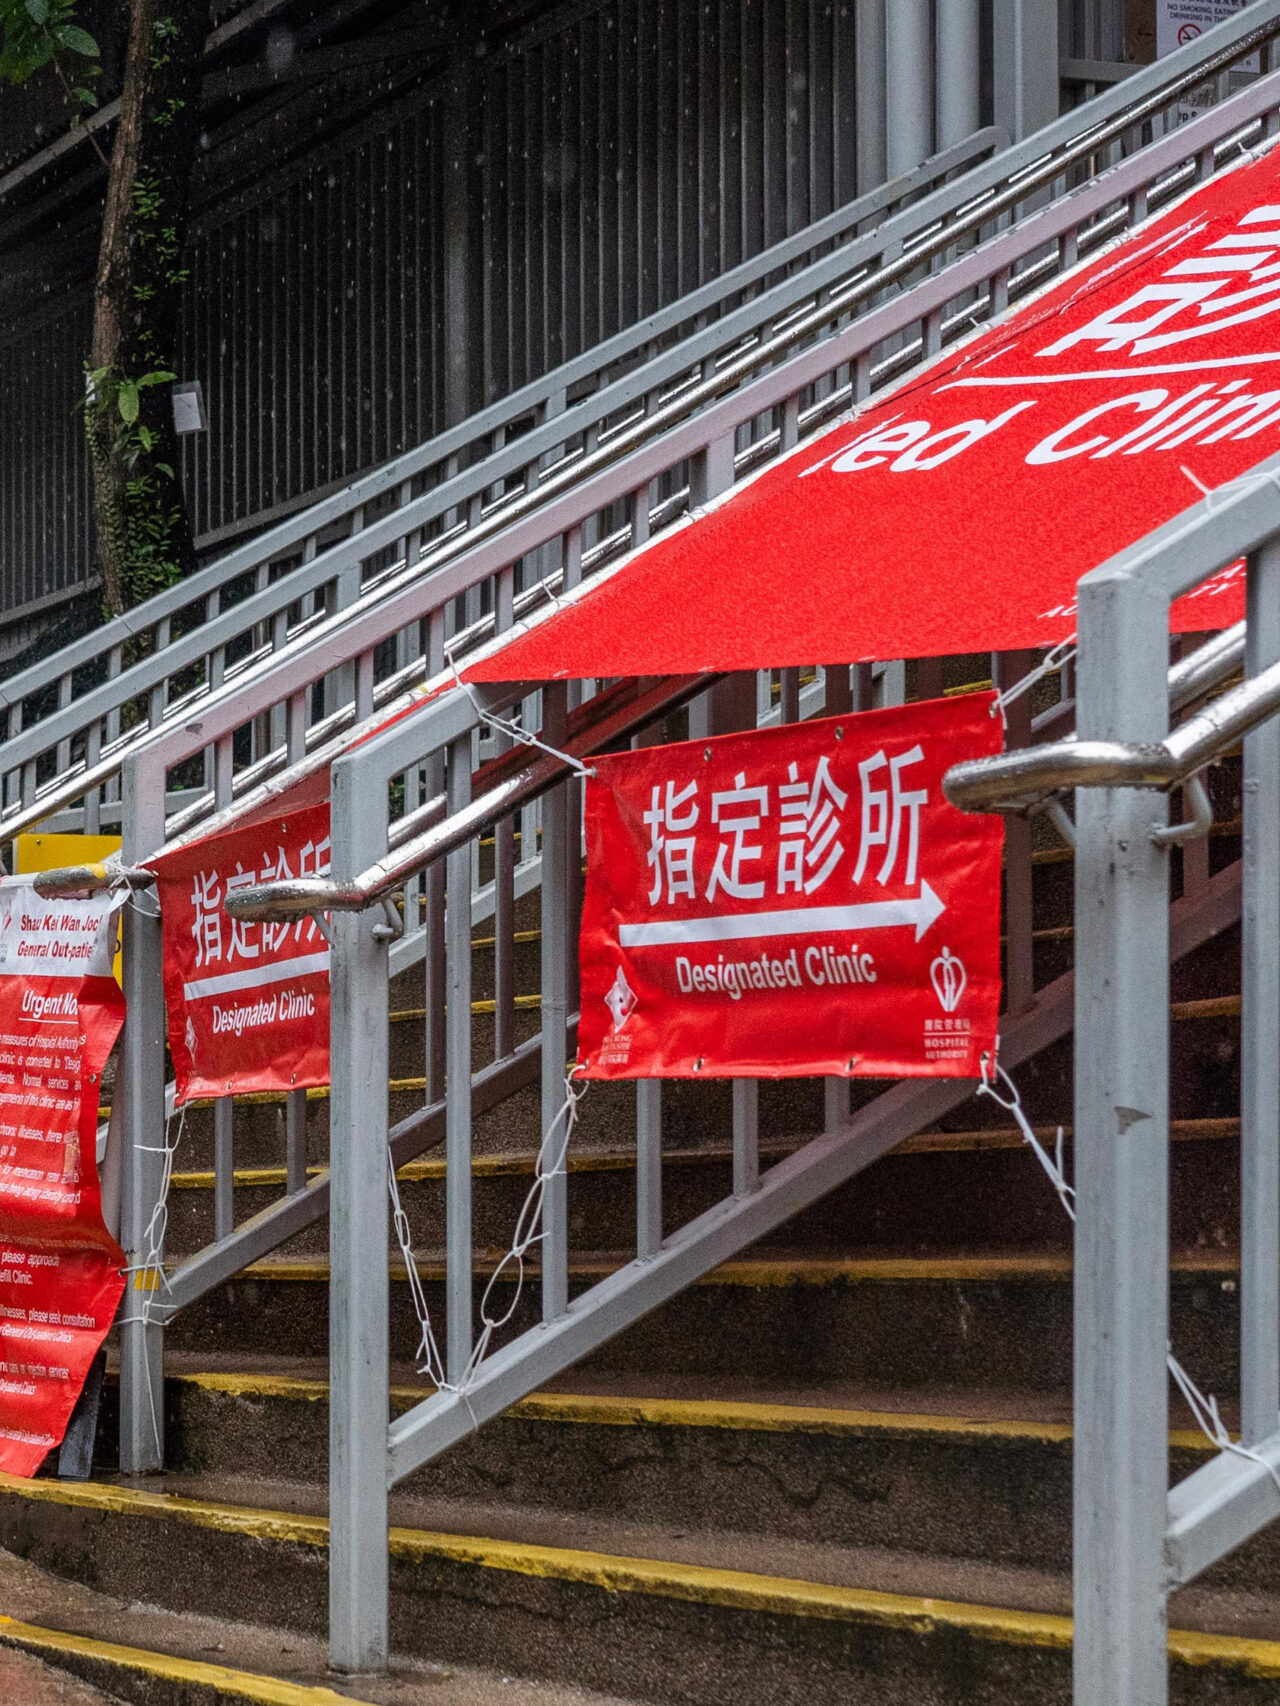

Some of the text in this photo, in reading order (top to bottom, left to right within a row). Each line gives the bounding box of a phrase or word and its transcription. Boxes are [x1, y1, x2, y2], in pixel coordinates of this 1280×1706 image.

[642, 743, 930, 906] 指定診所
[20, 915, 42, 932] Shau
[42, 915, 59, 931] Kei
[61, 915, 81, 932] Wan
[17, 941, 52, 958] General
[677, 943, 879, 1001] Designated Clinic
[21, 989, 62, 1018] Urgent
[212, 988, 316, 1037] Designated Clinic
[0, 1051, 15, 1064] clinic
[23, 1072, 43, 1087] Normal
[48, 1076, 69, 1089] services
[0, 1145, 9, 1157] go
[2, 1249, 26, 1264] please
[28, 1253, 60, 1268] approach
[13, 1269, 34, 1284] Clinic.
[29, 1307, 49, 1323] please
[49, 1307, 62, 1323] seek
[63, 1311, 96, 1328] consultation
